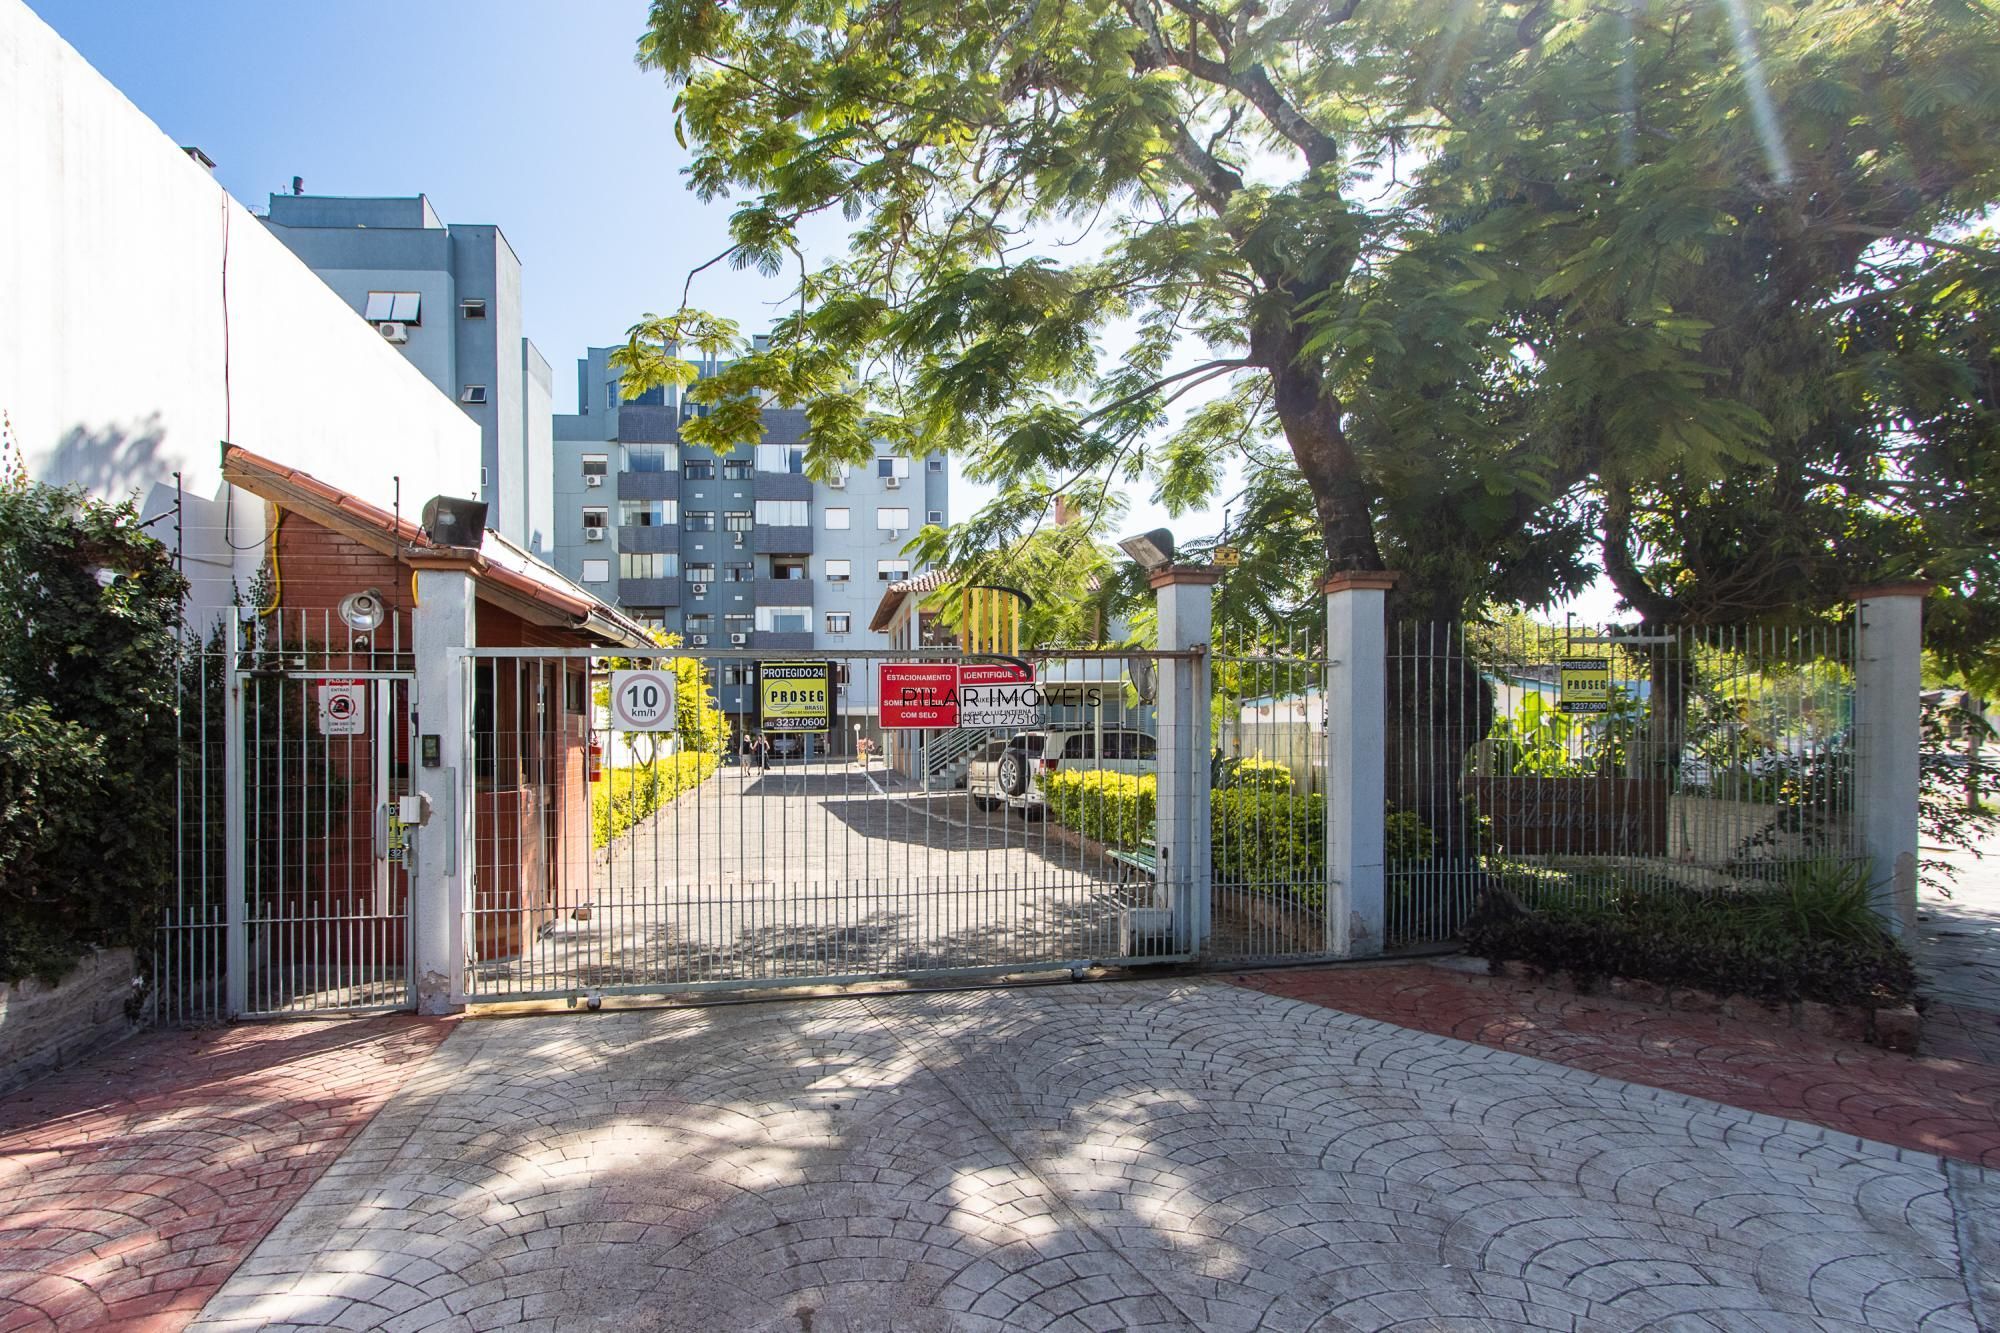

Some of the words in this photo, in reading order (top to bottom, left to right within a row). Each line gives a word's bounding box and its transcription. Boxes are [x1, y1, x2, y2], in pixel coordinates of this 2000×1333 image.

[1561, 661, 1597, 669] PROTEGIDO
[763, 668, 812, 678] PROTEGIDO
[963, 670, 1013, 680] IDENTIFIQUE
[1567, 679, 1606, 690] PROSEG
[627, 685, 658, 708] 10
[771, 690, 824, 703] PROSEG
[1571, 702, 1607, 710] 3237.0600
[631, 708, 656, 717] km/h
[900, 711, 918, 719] COM
[918, 711, 938, 719] SELO
[776, 717, 826, 727] 3237.0600
